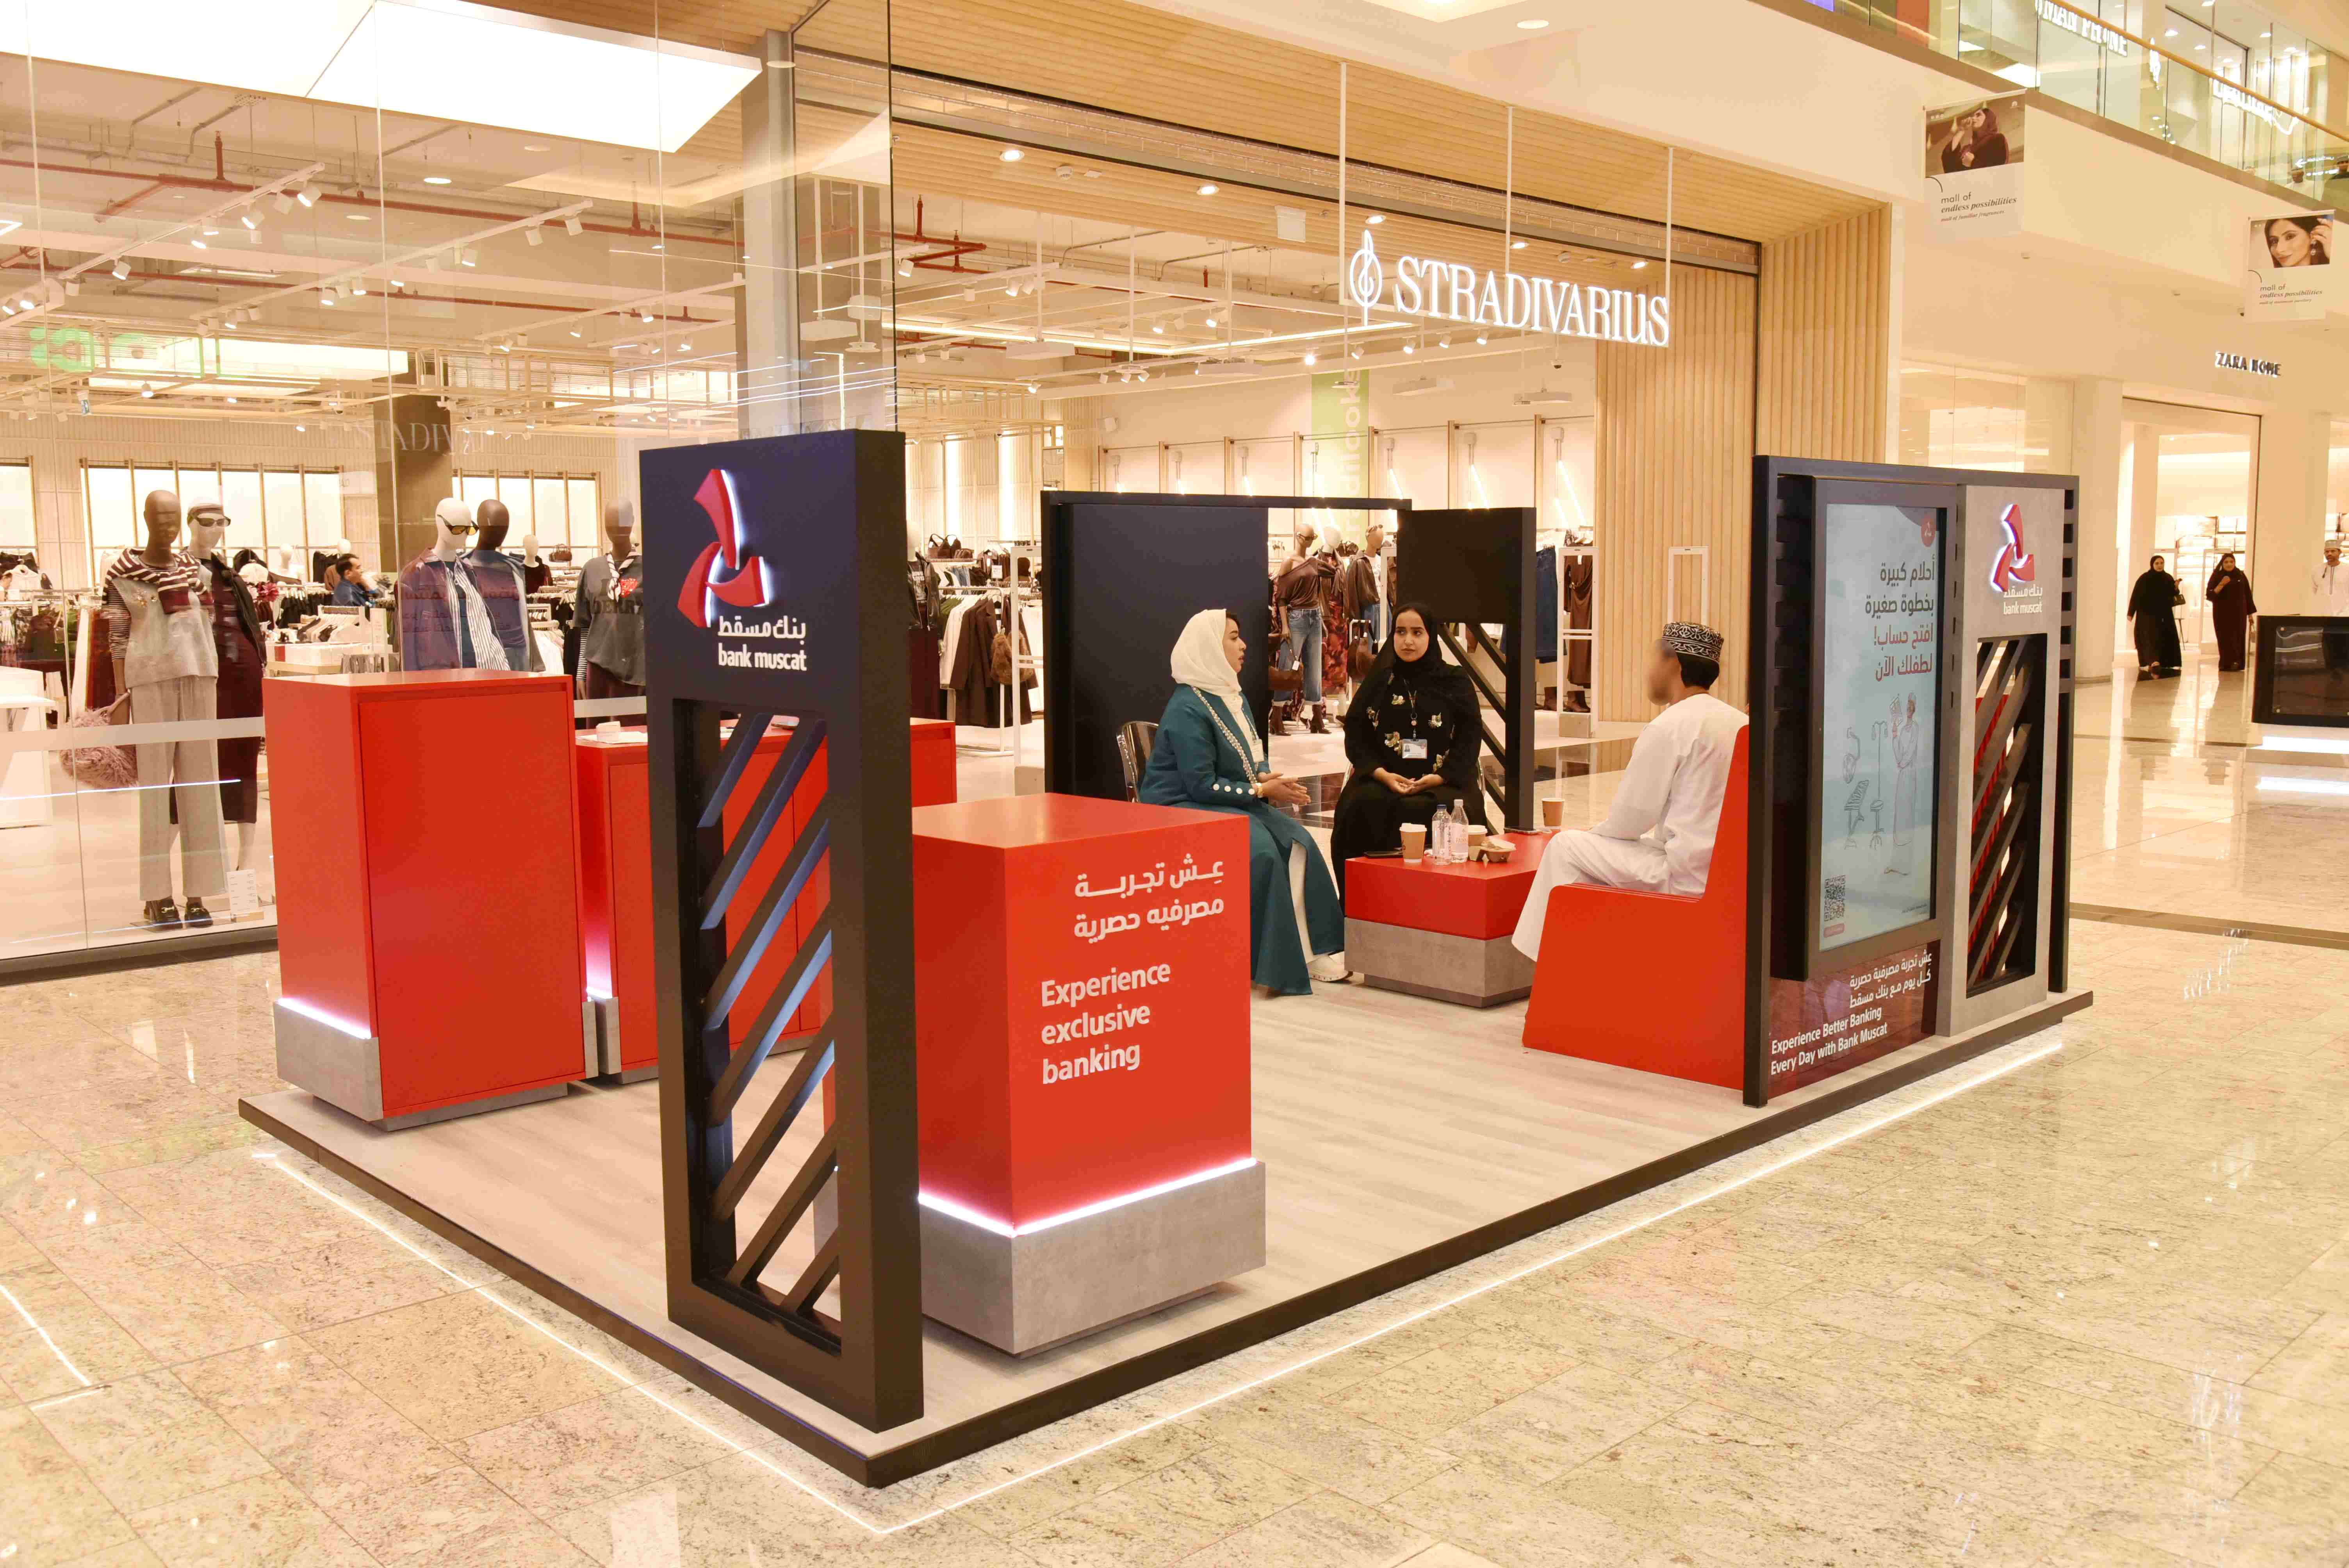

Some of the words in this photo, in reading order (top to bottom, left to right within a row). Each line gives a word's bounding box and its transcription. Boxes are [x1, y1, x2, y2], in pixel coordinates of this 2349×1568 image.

[1941, 193, 1959, 203] mall
[1962, 192, 1971, 200] of
[1941, 204, 1969, 213] endless
[1971, 197, 2017, 210] possibilities
[1394, 256, 1669, 347] STRADIVARIUS
[2215, 351, 2247, 370] ZARA
[1880, 562, 1906, 587] كبيرة
[1910, 554, 1934, 587] أحلام
[2029, 584, 2042, 599] بنك
[1865, 594, 1897, 619] صغيرة
[1901, 592, 1934, 617] بخطوة
[2003, 601, 2019, 615] bank
[2020, 602, 2042, 614] muscat
[718, 615, 771, 637] مسقط
[773, 615, 806, 645] بنك
[1912, 622, 1933, 650] افتح
[718, 643, 752, 667] bank
[754, 650, 807, 671] muscat
[1876, 656, 1894, 682] الآن
[1898, 653, 1932, 675] لطفلك
[1147, 898, 1224, 930] مصرفيه
[1074, 913, 1140, 944] حصرية
[1873, 964, 1900, 982] مصرفية
[1901, 955, 1918, 973] تجربة
[1041, 964, 1171, 1007] Experience
[1850, 974, 1871, 990] حصرية
[1875, 984, 1889, 999] بنك
[1890, 982, 1901, 998] مع
[1903, 978, 1916, 993] يوم
[1850, 992, 1874, 1008] مسقط
[1041, 1004, 1150, 1045] exclusive
[1772, 1028, 1820, 1055] Experience
[1823, 1017, 1849, 1037] Better
[1850, 1007, 1882, 1028] Banking
[1771, 1057, 1797, 1075] Every
[1798, 1049, 1815, 1066] Day
[1817, 1041, 1836, 1059] with
[1838, 1033, 1859, 1051] Bank
[1860, 1022, 1887, 1044] Muscat
[1043, 1044, 1140, 1084] banking
